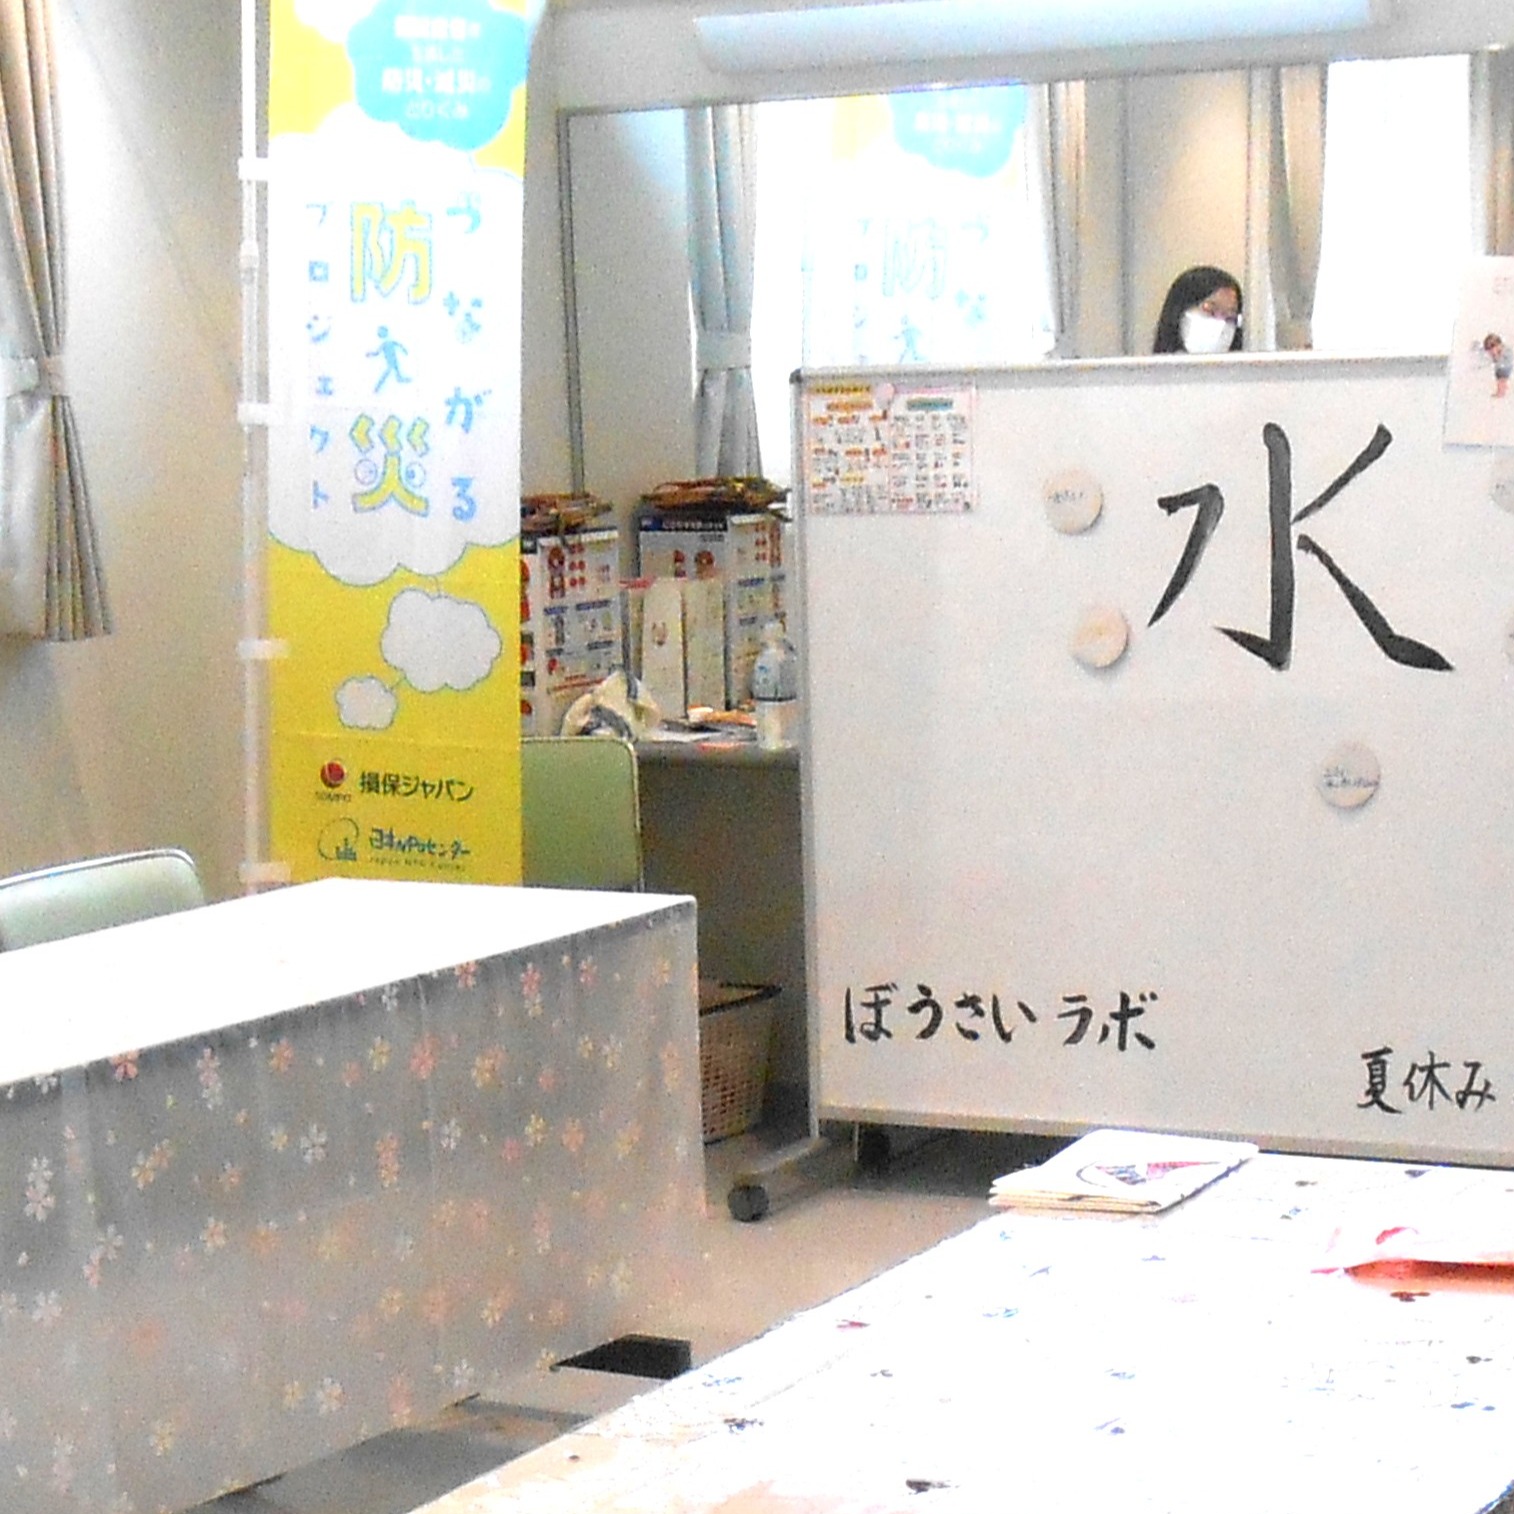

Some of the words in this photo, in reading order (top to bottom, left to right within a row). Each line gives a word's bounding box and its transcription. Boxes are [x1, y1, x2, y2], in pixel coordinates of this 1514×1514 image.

[1147, 421, 1455, 672] 水
[360, 771, 474, 802] 損保ジャパン
